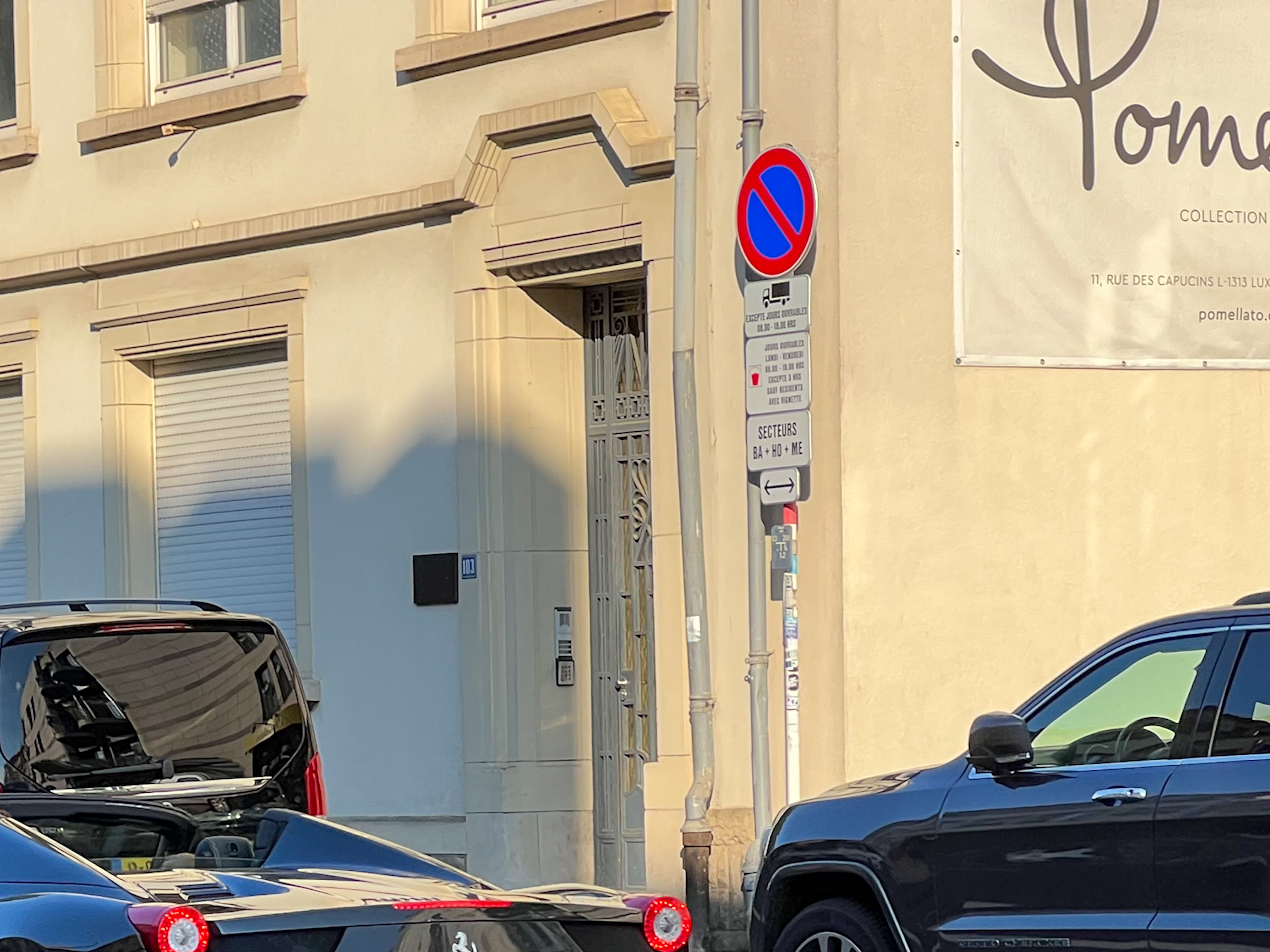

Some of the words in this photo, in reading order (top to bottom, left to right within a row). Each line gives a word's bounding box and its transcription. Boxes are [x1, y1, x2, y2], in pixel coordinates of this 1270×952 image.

[1180, 209, 1267, 224] COLLECTION
[1091, 274, 1103, 287] 11,
[1107, 274, 1129, 286] RUE
[1133, 274, 1154, 286] DES
[1158, 275, 1214, 287] CAPUCINS
[1218, 276, 1248, 288] L-1313
[766, 311, 780, 320] JOURS
[1199, 307, 1270, 323] pomellato.
[758, 422, 797, 440] SECTEURS
[753, 446, 763, 460] BA
[772, 443, 782, 457] HO
[792, 441, 803, 456] ME
[462, 558, 476, 575] 103
